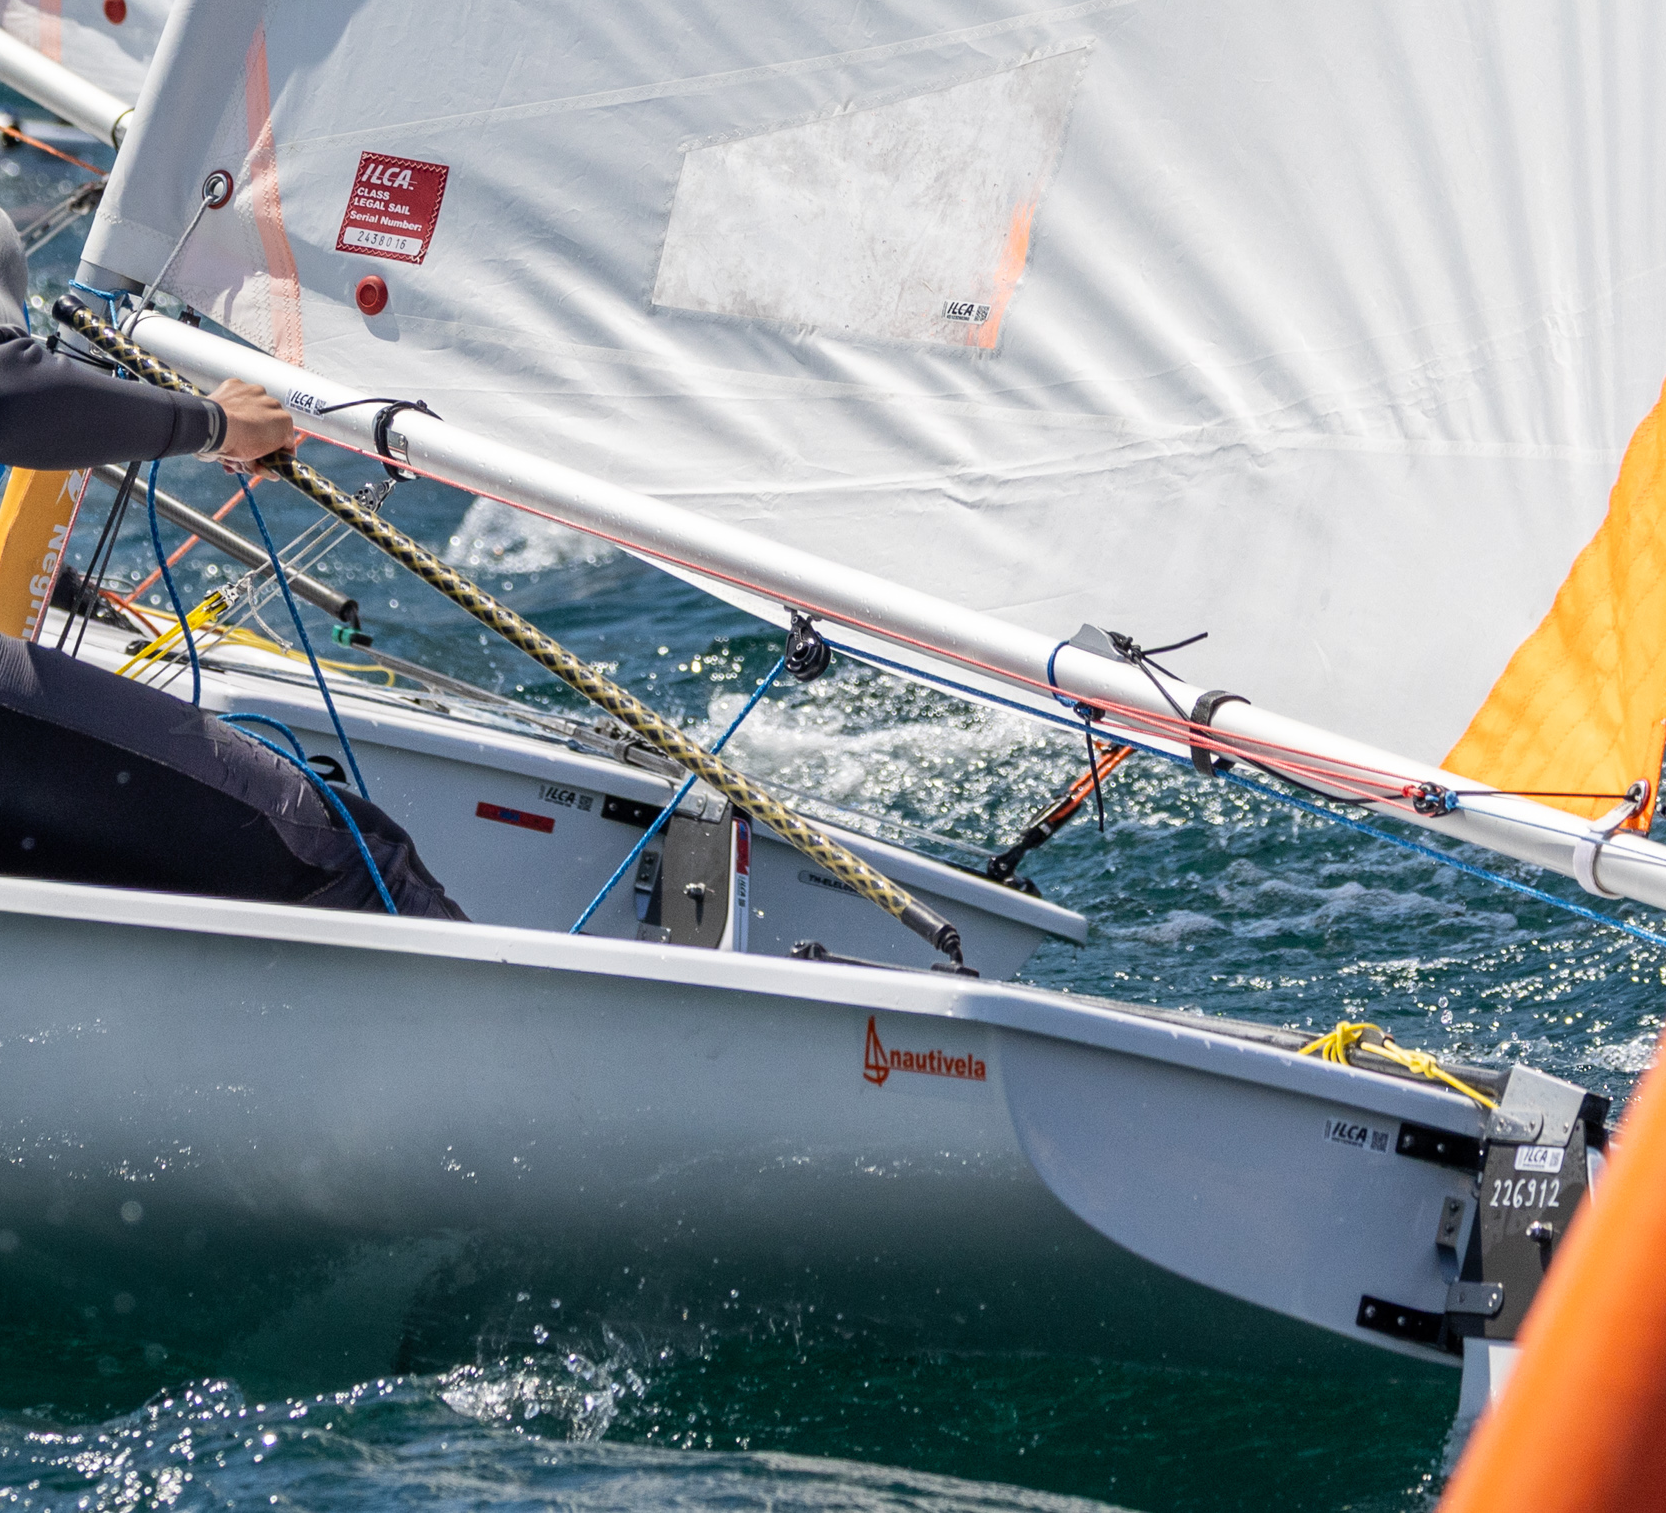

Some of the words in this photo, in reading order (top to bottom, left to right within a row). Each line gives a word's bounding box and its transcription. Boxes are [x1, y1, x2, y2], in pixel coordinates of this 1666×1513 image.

[361, 163, 413, 189] ILCA
[357, 187, 390, 200] CLASS
[354, 197, 385, 210] LEGAL
[388, 203, 410, 215] SAIL
[350, 211, 378, 223] Serial
[380, 216, 422, 231] Number:
[947, 301, 975, 316] ILCA
[290, 390, 314, 409] ILCA
[545, 786, 576, 804] ILCA
[889, 1049, 986, 1079] nautivela
[1332, 1121, 1367, 1143] ILCA
[1523, 1147, 1548, 1162] ILCA
[1489, 1178, 1560, 1208] 226912
